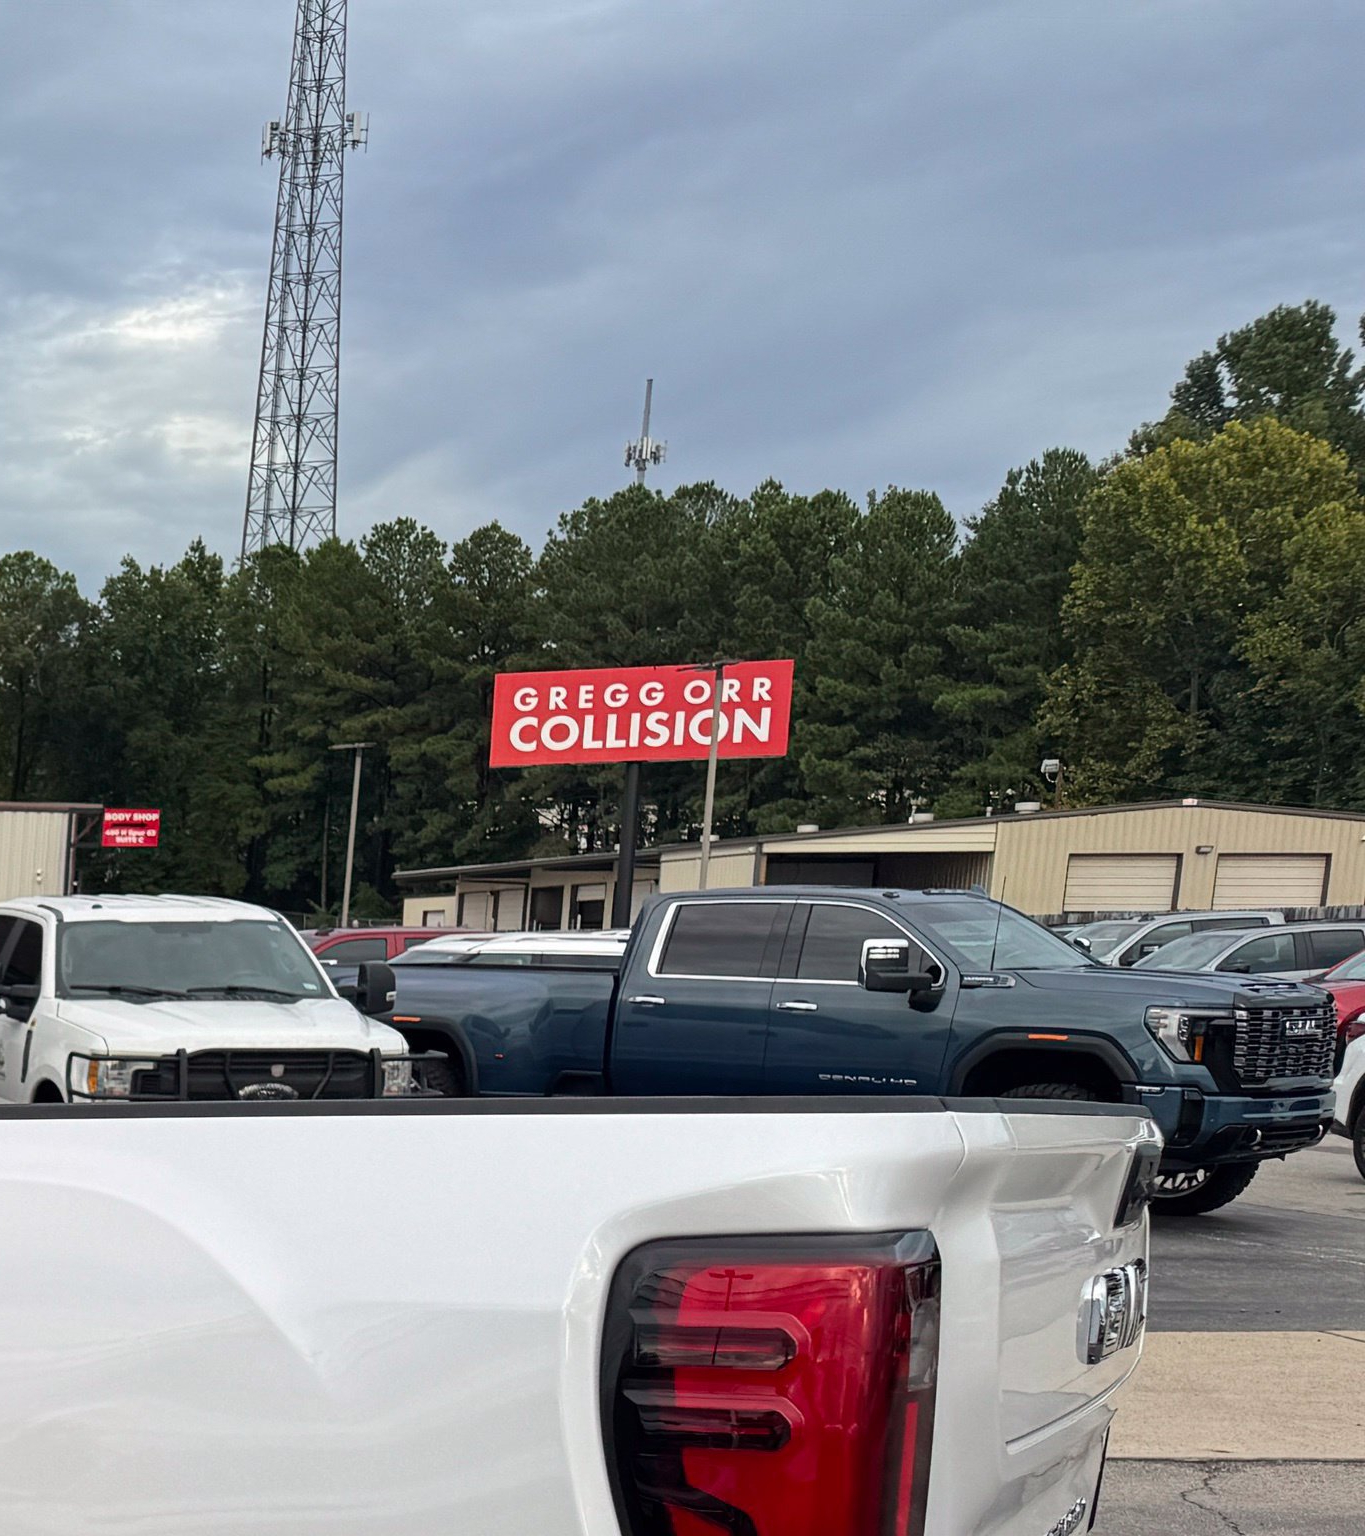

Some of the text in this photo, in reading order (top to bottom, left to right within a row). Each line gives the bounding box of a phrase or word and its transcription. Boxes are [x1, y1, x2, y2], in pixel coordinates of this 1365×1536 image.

[513, 677, 773, 712] GREGG ORR
[508, 707, 772, 752] COLLISION
[104, 812, 160, 822] BODY SHOP
[818, 1073, 886, 1084] DENALI
